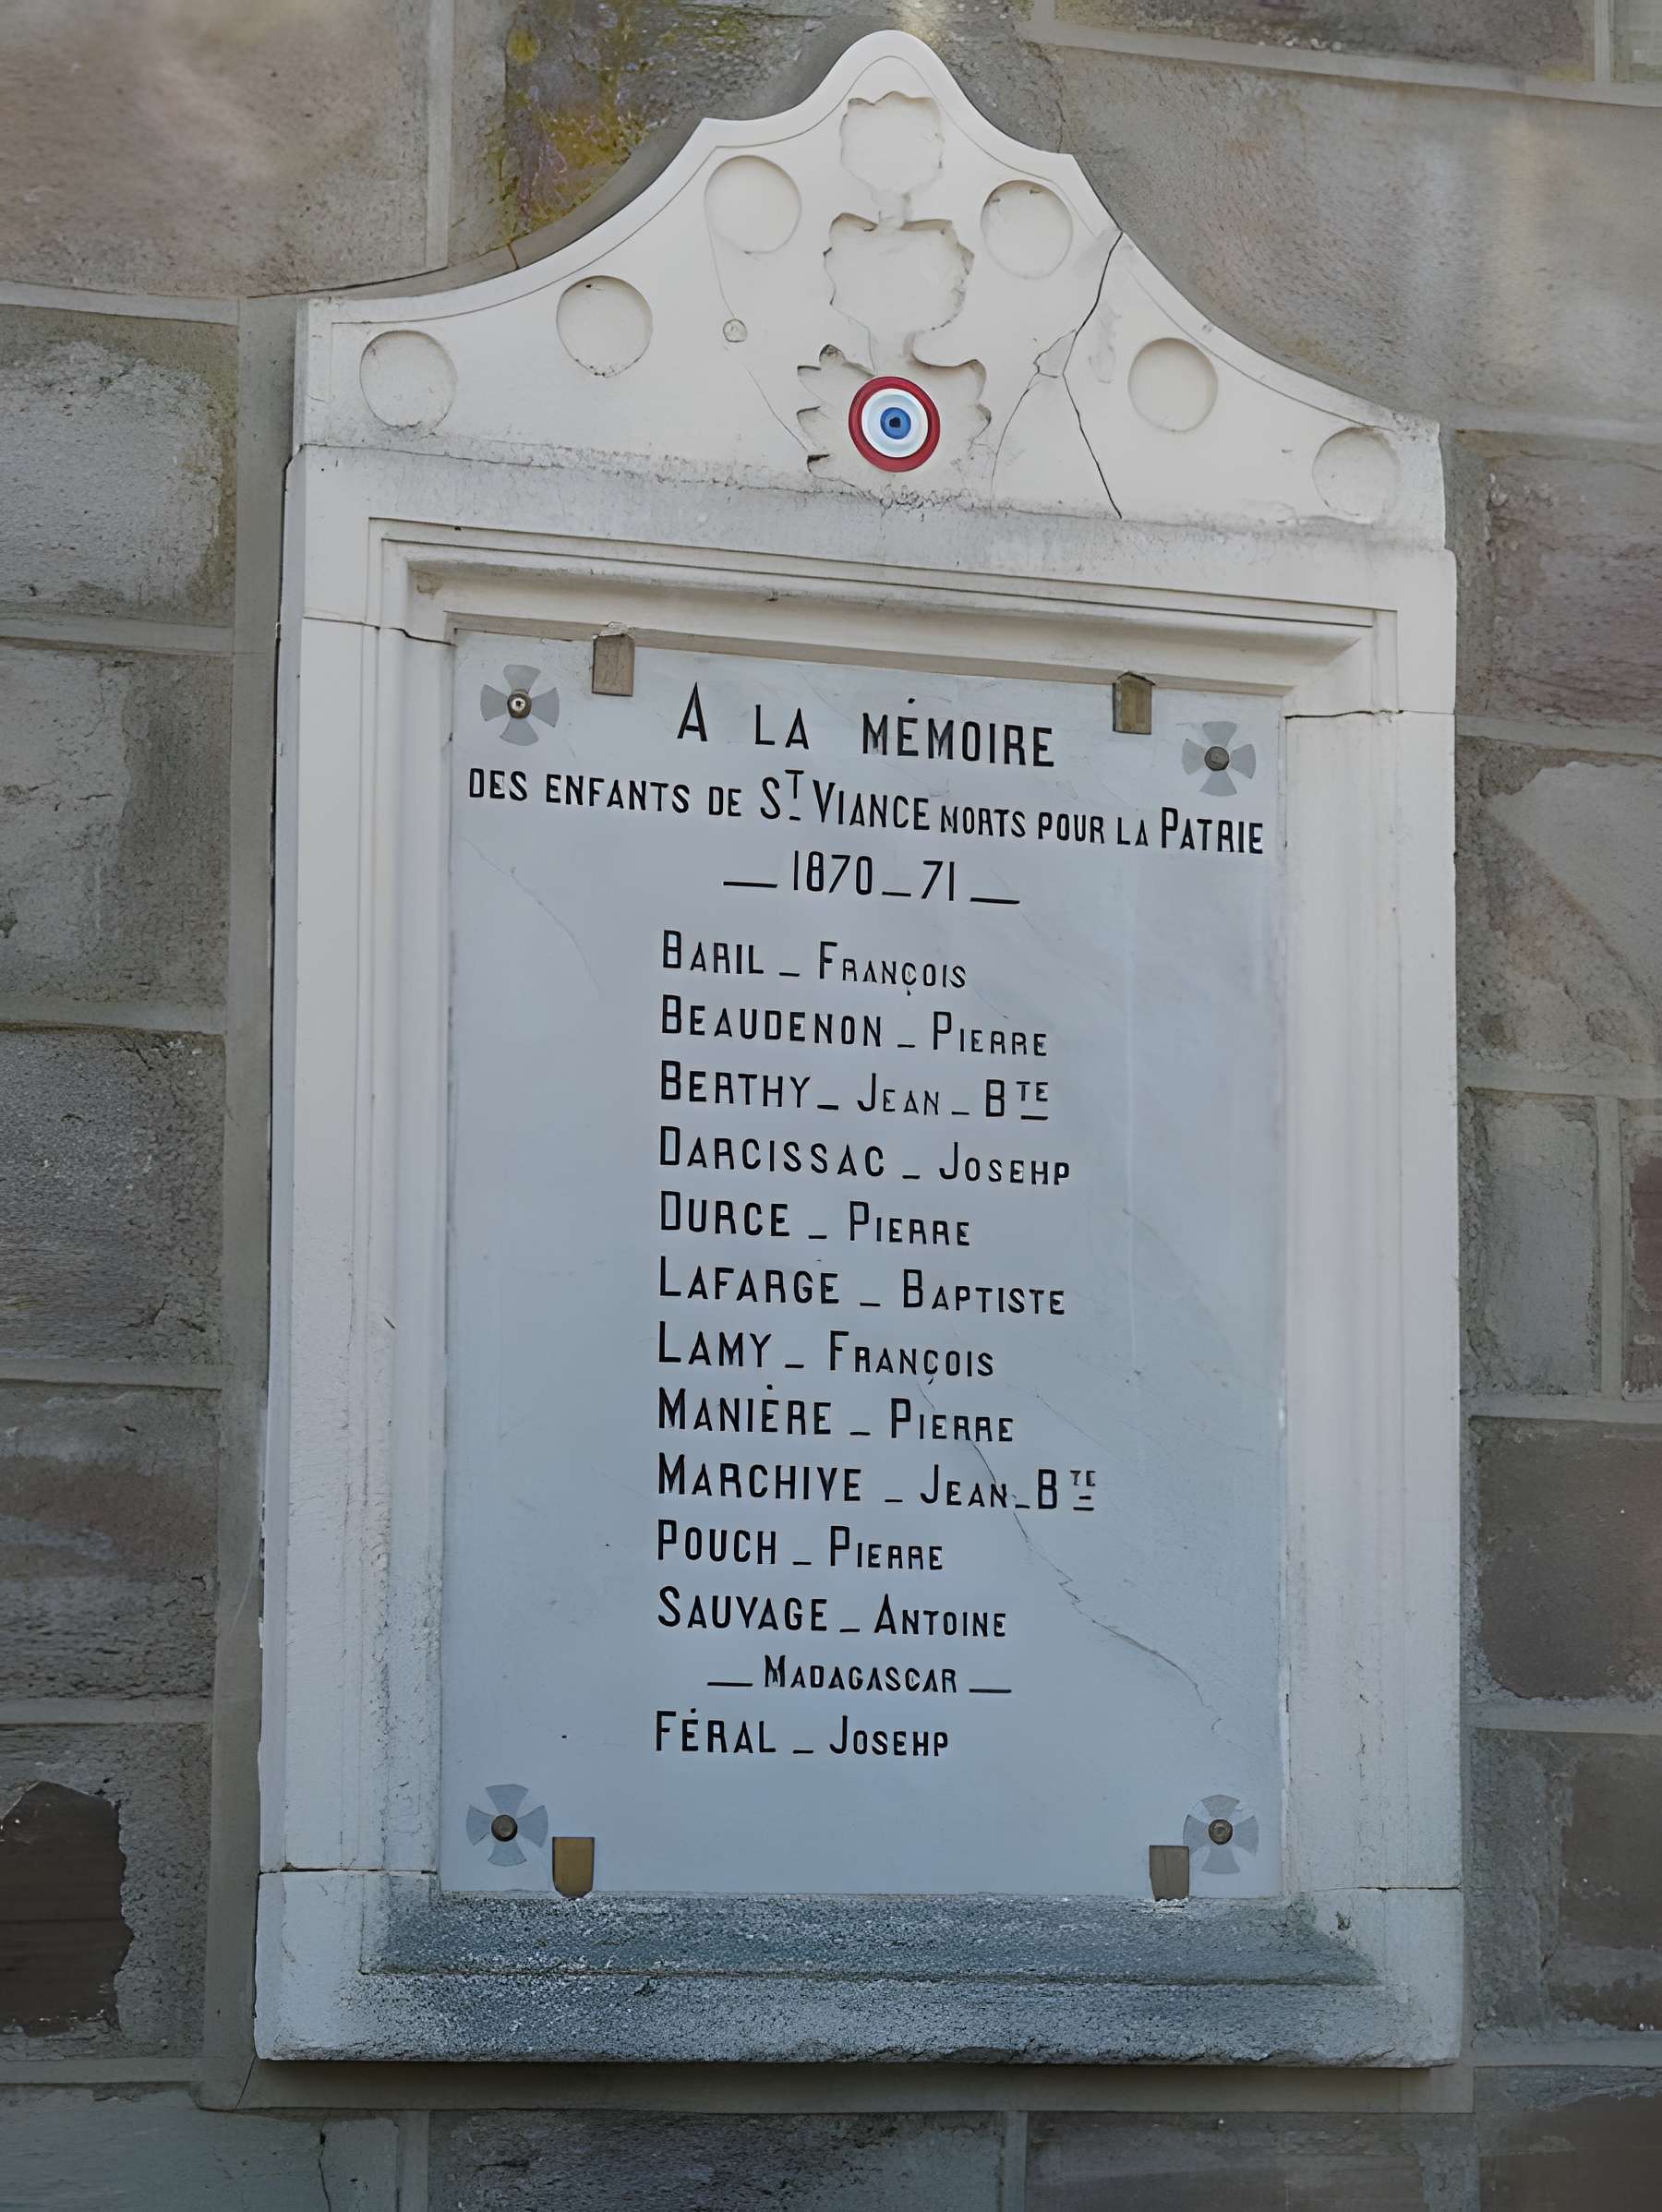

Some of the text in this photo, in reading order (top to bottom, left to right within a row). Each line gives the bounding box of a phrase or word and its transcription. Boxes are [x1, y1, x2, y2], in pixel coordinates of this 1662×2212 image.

[677, 682, 708, 742] A
[755, 704, 810, 750] LA
[469, 767, 528, 802] DES
[546, 773, 691, 814] ENFANTS
[708, 786, 742, 817] DE
[812, 779, 930, 831] VIANCE
[1037, 811, 1105, 845] POUR
[1116, 817, 1150, 848] LA
[1161, 806, 1264, 855] PATRIE
[662, 929, 967, 997] BARIL FRANÇOIS
[661, 993, 1047, 1057] BEAUDENON PIERRE
[660, 1059, 811, 1109] BERTHY
[857, 1072, 940, 1116] JEAN
[659, 1124, 1070, 1186] DARCISSAC JOSEHP
[660, 1190, 970, 1246] DURCE PIERRE
[659, 1255, 1066, 1316] LAFARGE BAPTISTE
[658, 1320, 994, 1386] LAMY FRANÇOIS
[890, 1397, 1014, 1442] PIERRE
[658, 1451, 861, 1502] MARCHIVE
[657, 1519, 944, 1571] POUCH PIERRE
[657, 1585, 1006, 1638] SAUVAGE ANTOINE
[764, 1654, 957, 1694] MADAGASCAR
[829, 1714, 948, 1757] JOSEHP
